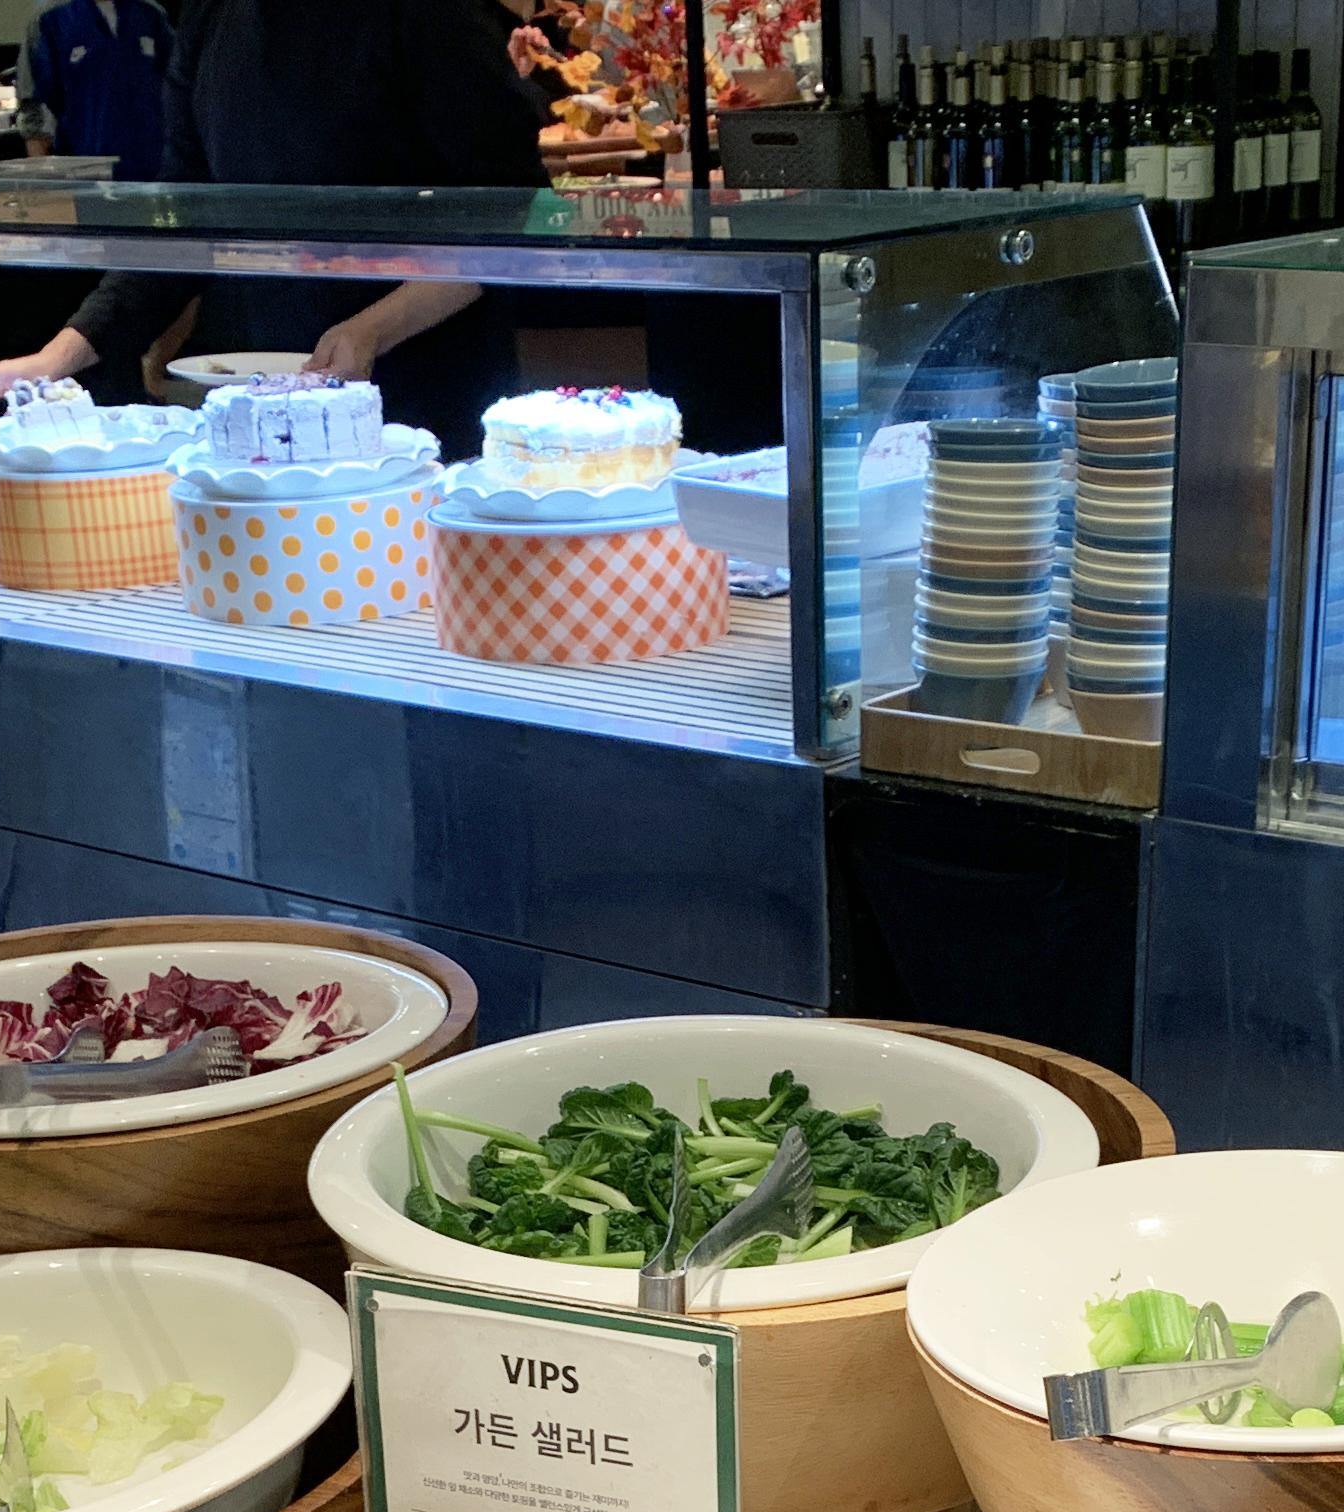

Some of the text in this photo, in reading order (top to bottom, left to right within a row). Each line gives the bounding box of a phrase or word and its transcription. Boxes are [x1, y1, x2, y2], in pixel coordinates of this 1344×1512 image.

[500, 1354, 579, 1394] VIPS
[454, 1408, 634, 1467] 가든 샐러드
[423, 1477, 447, 1490] 신선한
[458, 1484, 483, 1497] 채소와
[484, 1489, 510, 1502] 다양한
[529, 1483, 563, 1496] 조합으로
[565, 1489, 591, 1502] 즐기는
